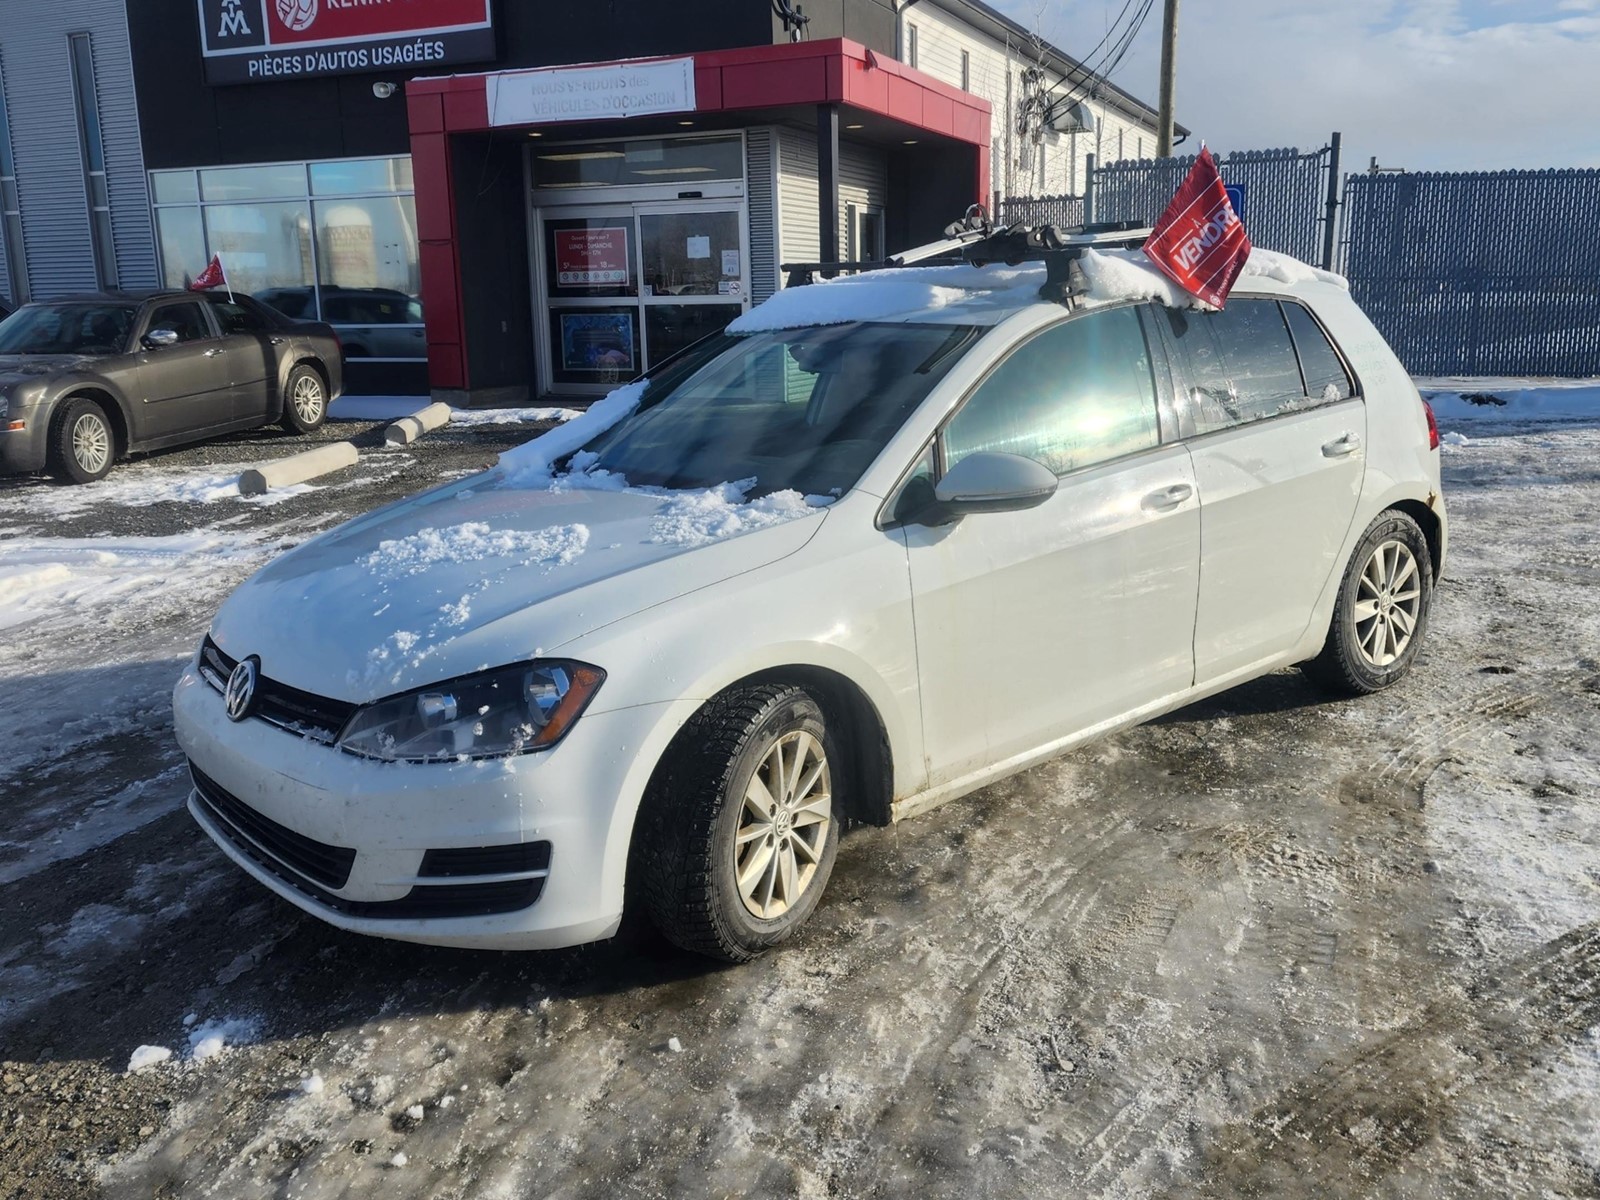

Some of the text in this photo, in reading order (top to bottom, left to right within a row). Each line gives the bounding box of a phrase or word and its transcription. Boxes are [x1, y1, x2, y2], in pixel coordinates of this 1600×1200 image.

[248, 39, 445, 77] PIÈCES D'AUTOS USAGÉES
[531, 81, 565, 95] NOUS
[629, 75, 649, 88] des
[602, 91, 677, 111] D'OCCASION
